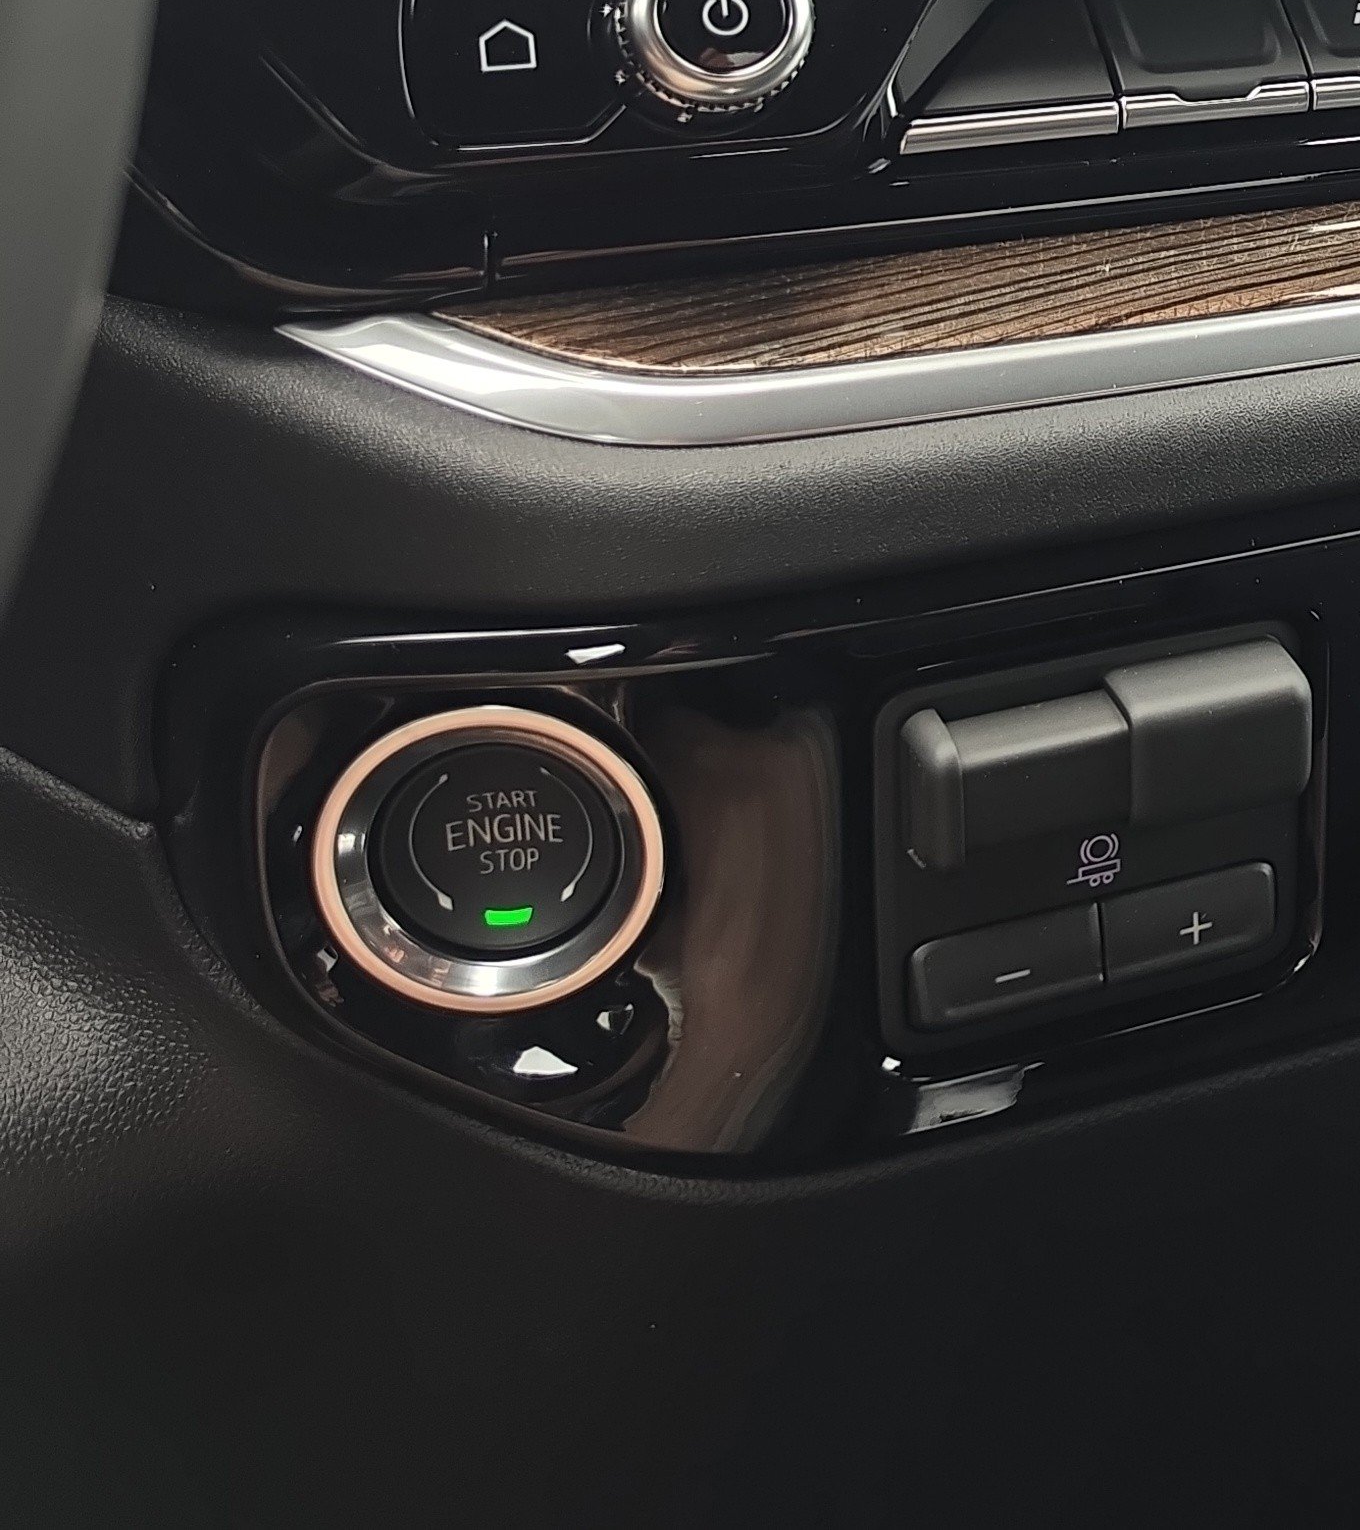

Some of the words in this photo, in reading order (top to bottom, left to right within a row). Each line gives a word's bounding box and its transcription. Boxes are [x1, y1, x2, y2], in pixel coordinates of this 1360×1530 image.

[467, 791, 536, 811] START
[446, 815, 562, 850] ENGINE
[480, 849, 538, 873] STOP
